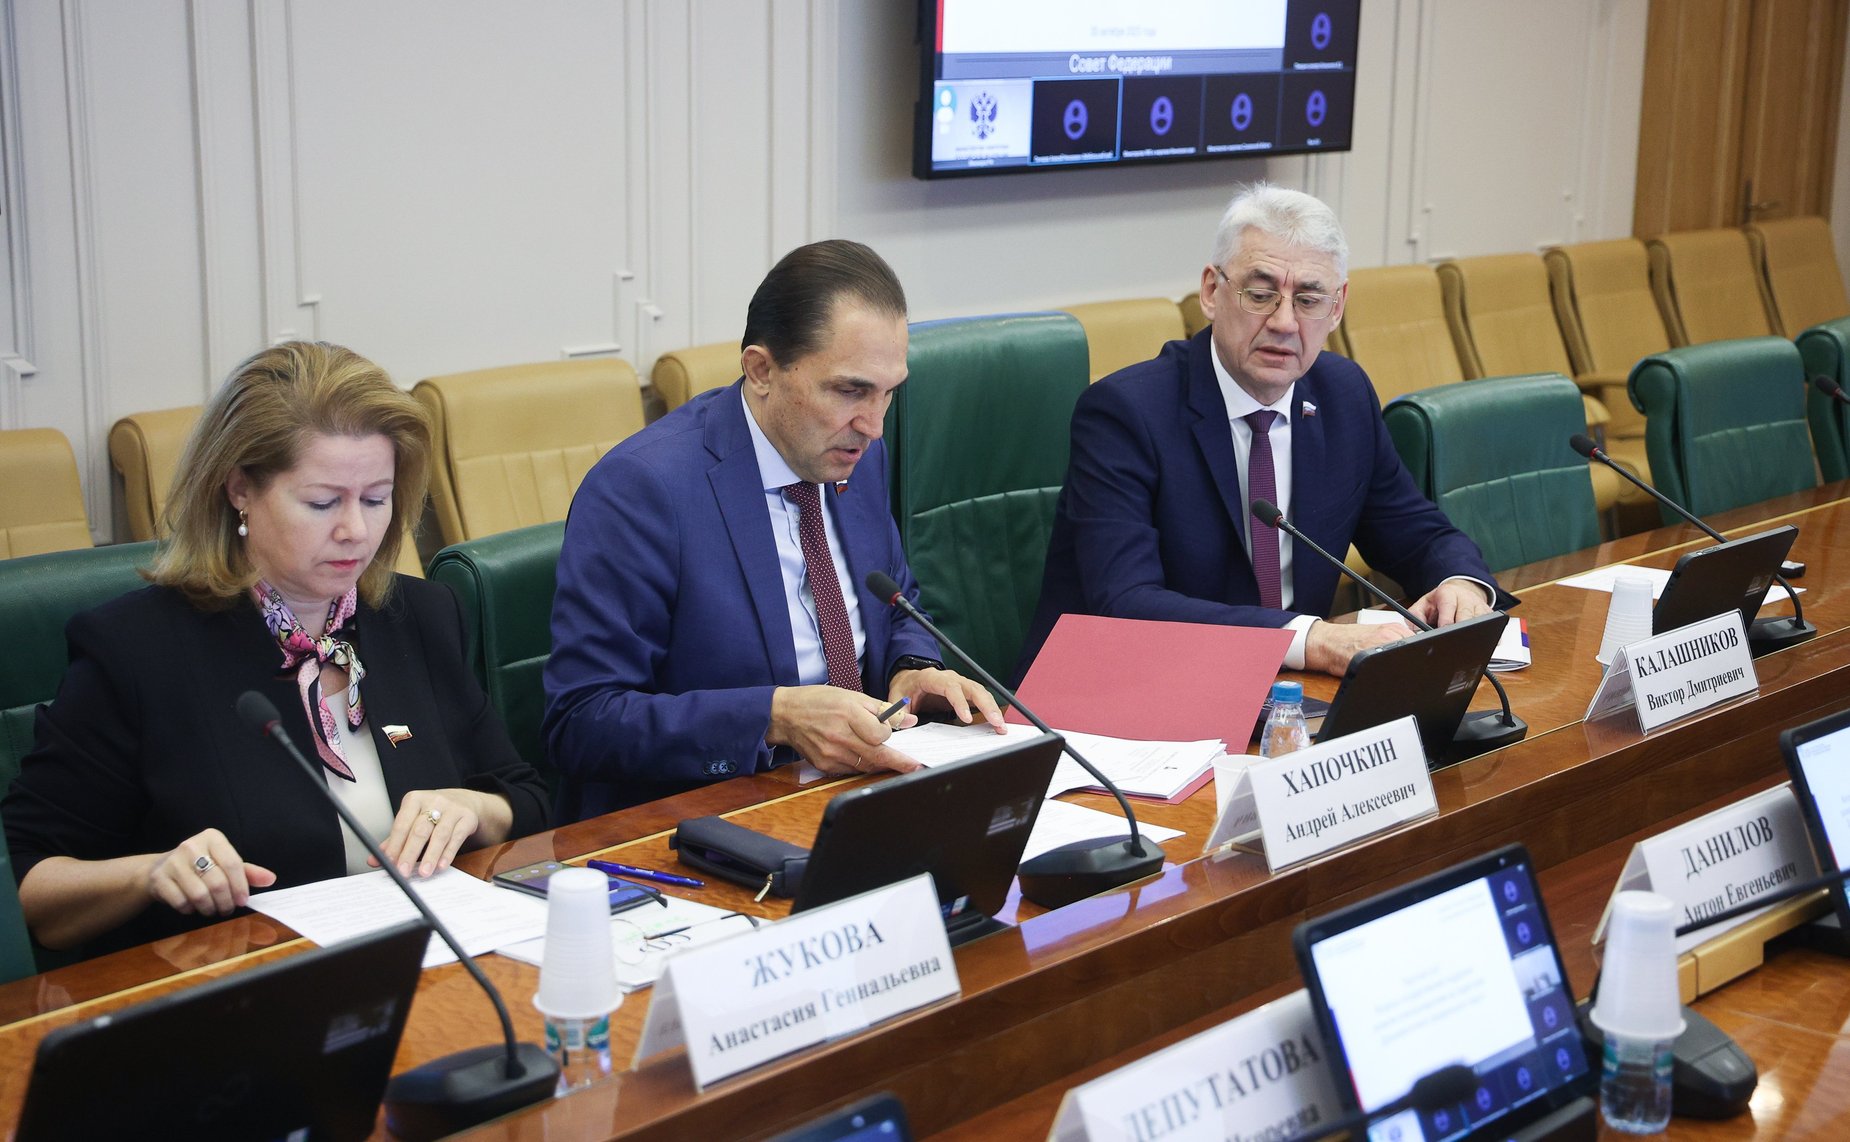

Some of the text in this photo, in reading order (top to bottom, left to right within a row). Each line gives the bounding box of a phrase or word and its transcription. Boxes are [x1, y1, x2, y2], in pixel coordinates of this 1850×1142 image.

[1069, 54, 1173, 75] Совет Федерации
[1635, 627, 1739, 678] КАЛАШНИКОВ
[1646, 687, 1685, 711] Виктор
[1687, 667, 1745, 700] Дмитриевич
[1281, 737, 1399, 797] ХАПОЧКИН
[1285, 807, 1338, 843] Андрей
[1341, 782, 1417, 823] Алексеевич
[1680, 815, 1775, 880] ДАНИЛОВ
[1684, 862, 1799, 925] Антон Евгеньевич
[744, 918, 886, 988] ЖУКОВА
[708, 956, 942, 1056] Анастасия Геннадьевна
